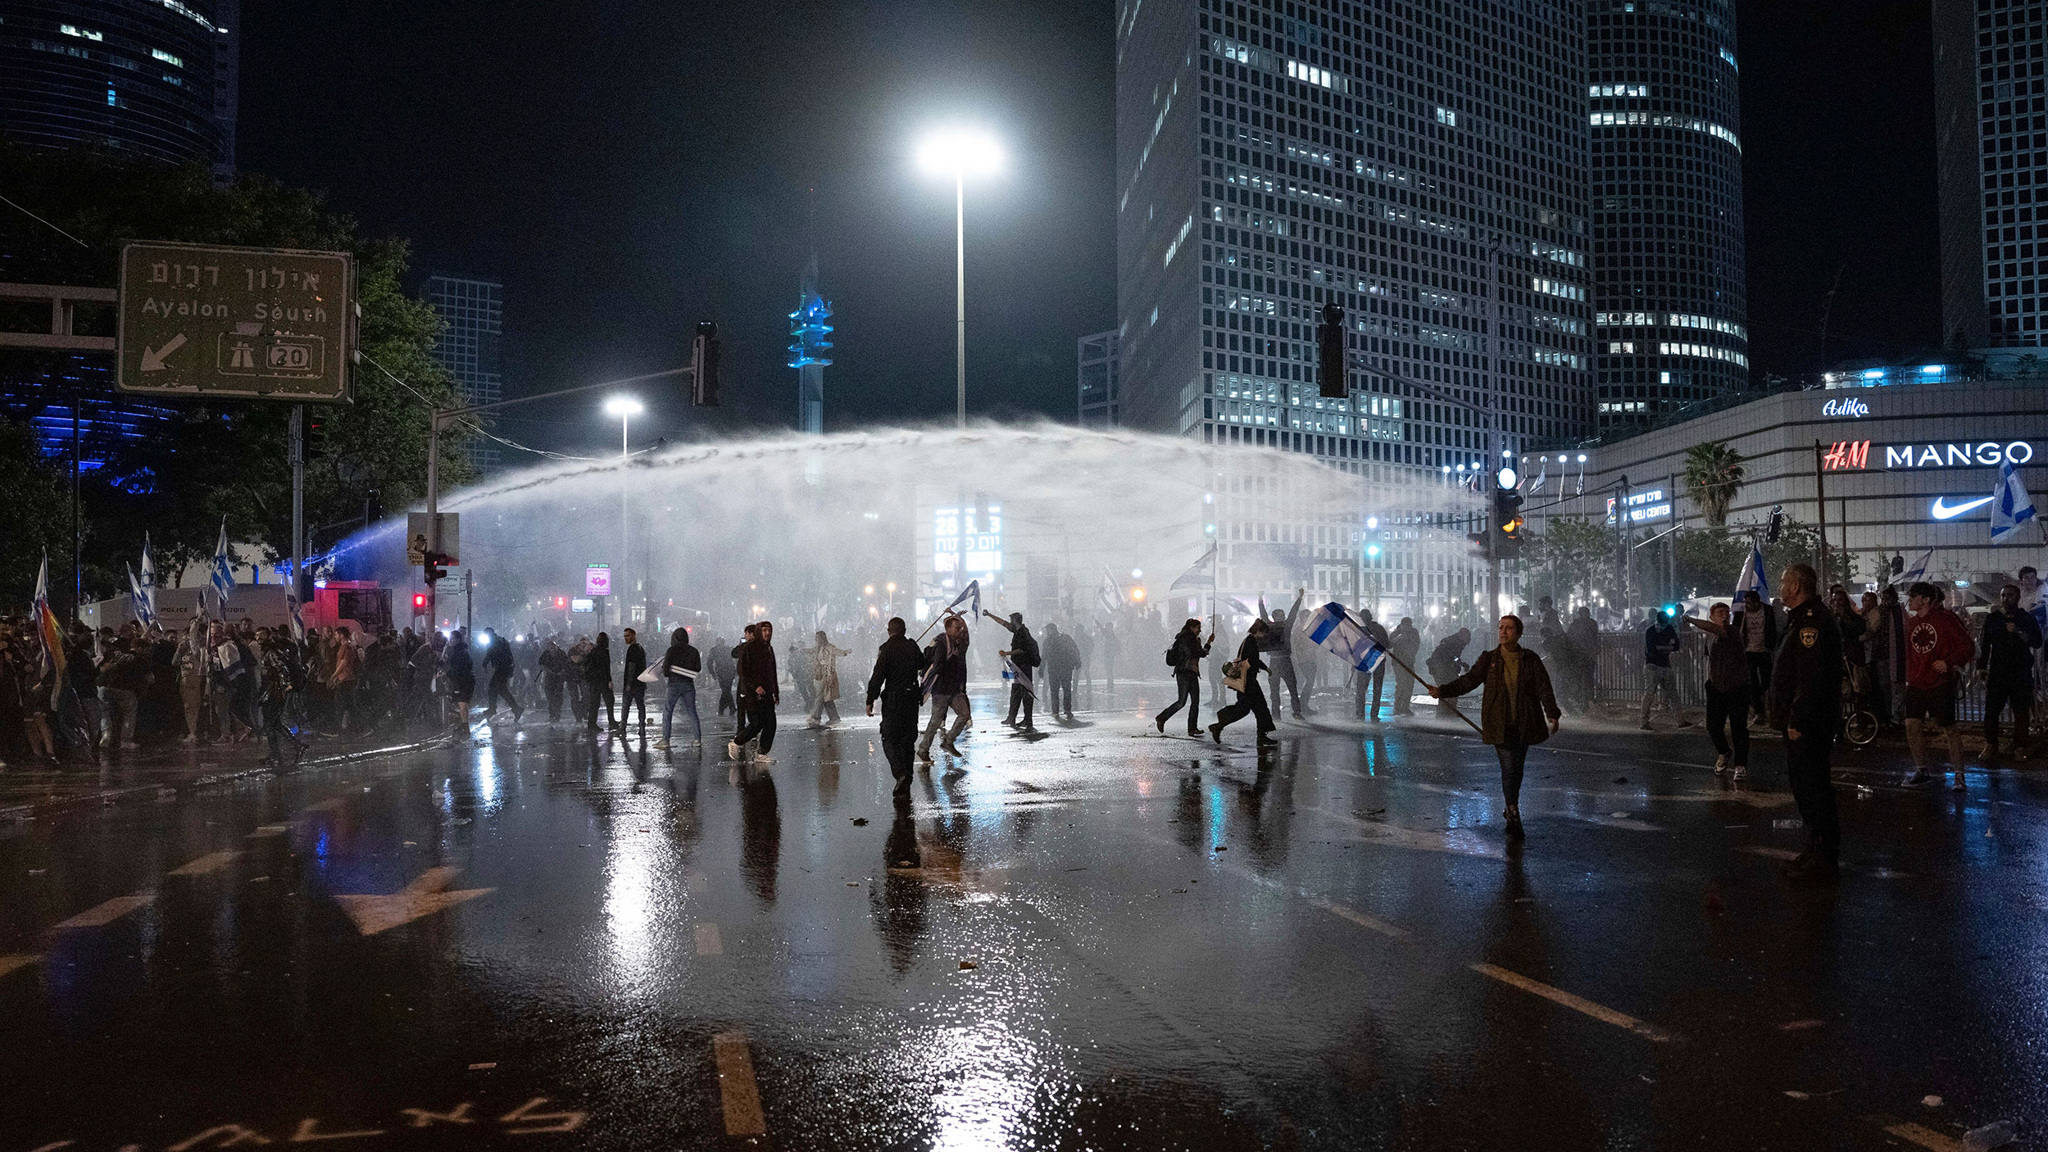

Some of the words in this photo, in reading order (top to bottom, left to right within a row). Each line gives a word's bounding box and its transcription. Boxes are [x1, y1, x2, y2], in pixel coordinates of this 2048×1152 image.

[152, 262, 220, 286] דרום
[245, 267, 321, 291] אילון
[141, 297, 229, 318] Ayalon
[254, 302, 327, 323] South
[276, 347, 302, 366] 20
[1822, 397, 1870, 418] Adika
[1823, 440, 1871, 470] H&M
[1886, 441, 2034, 468] MANGO
[1646, 504, 1671, 519] CENTER
[978, 535, 1000, 550] יום
